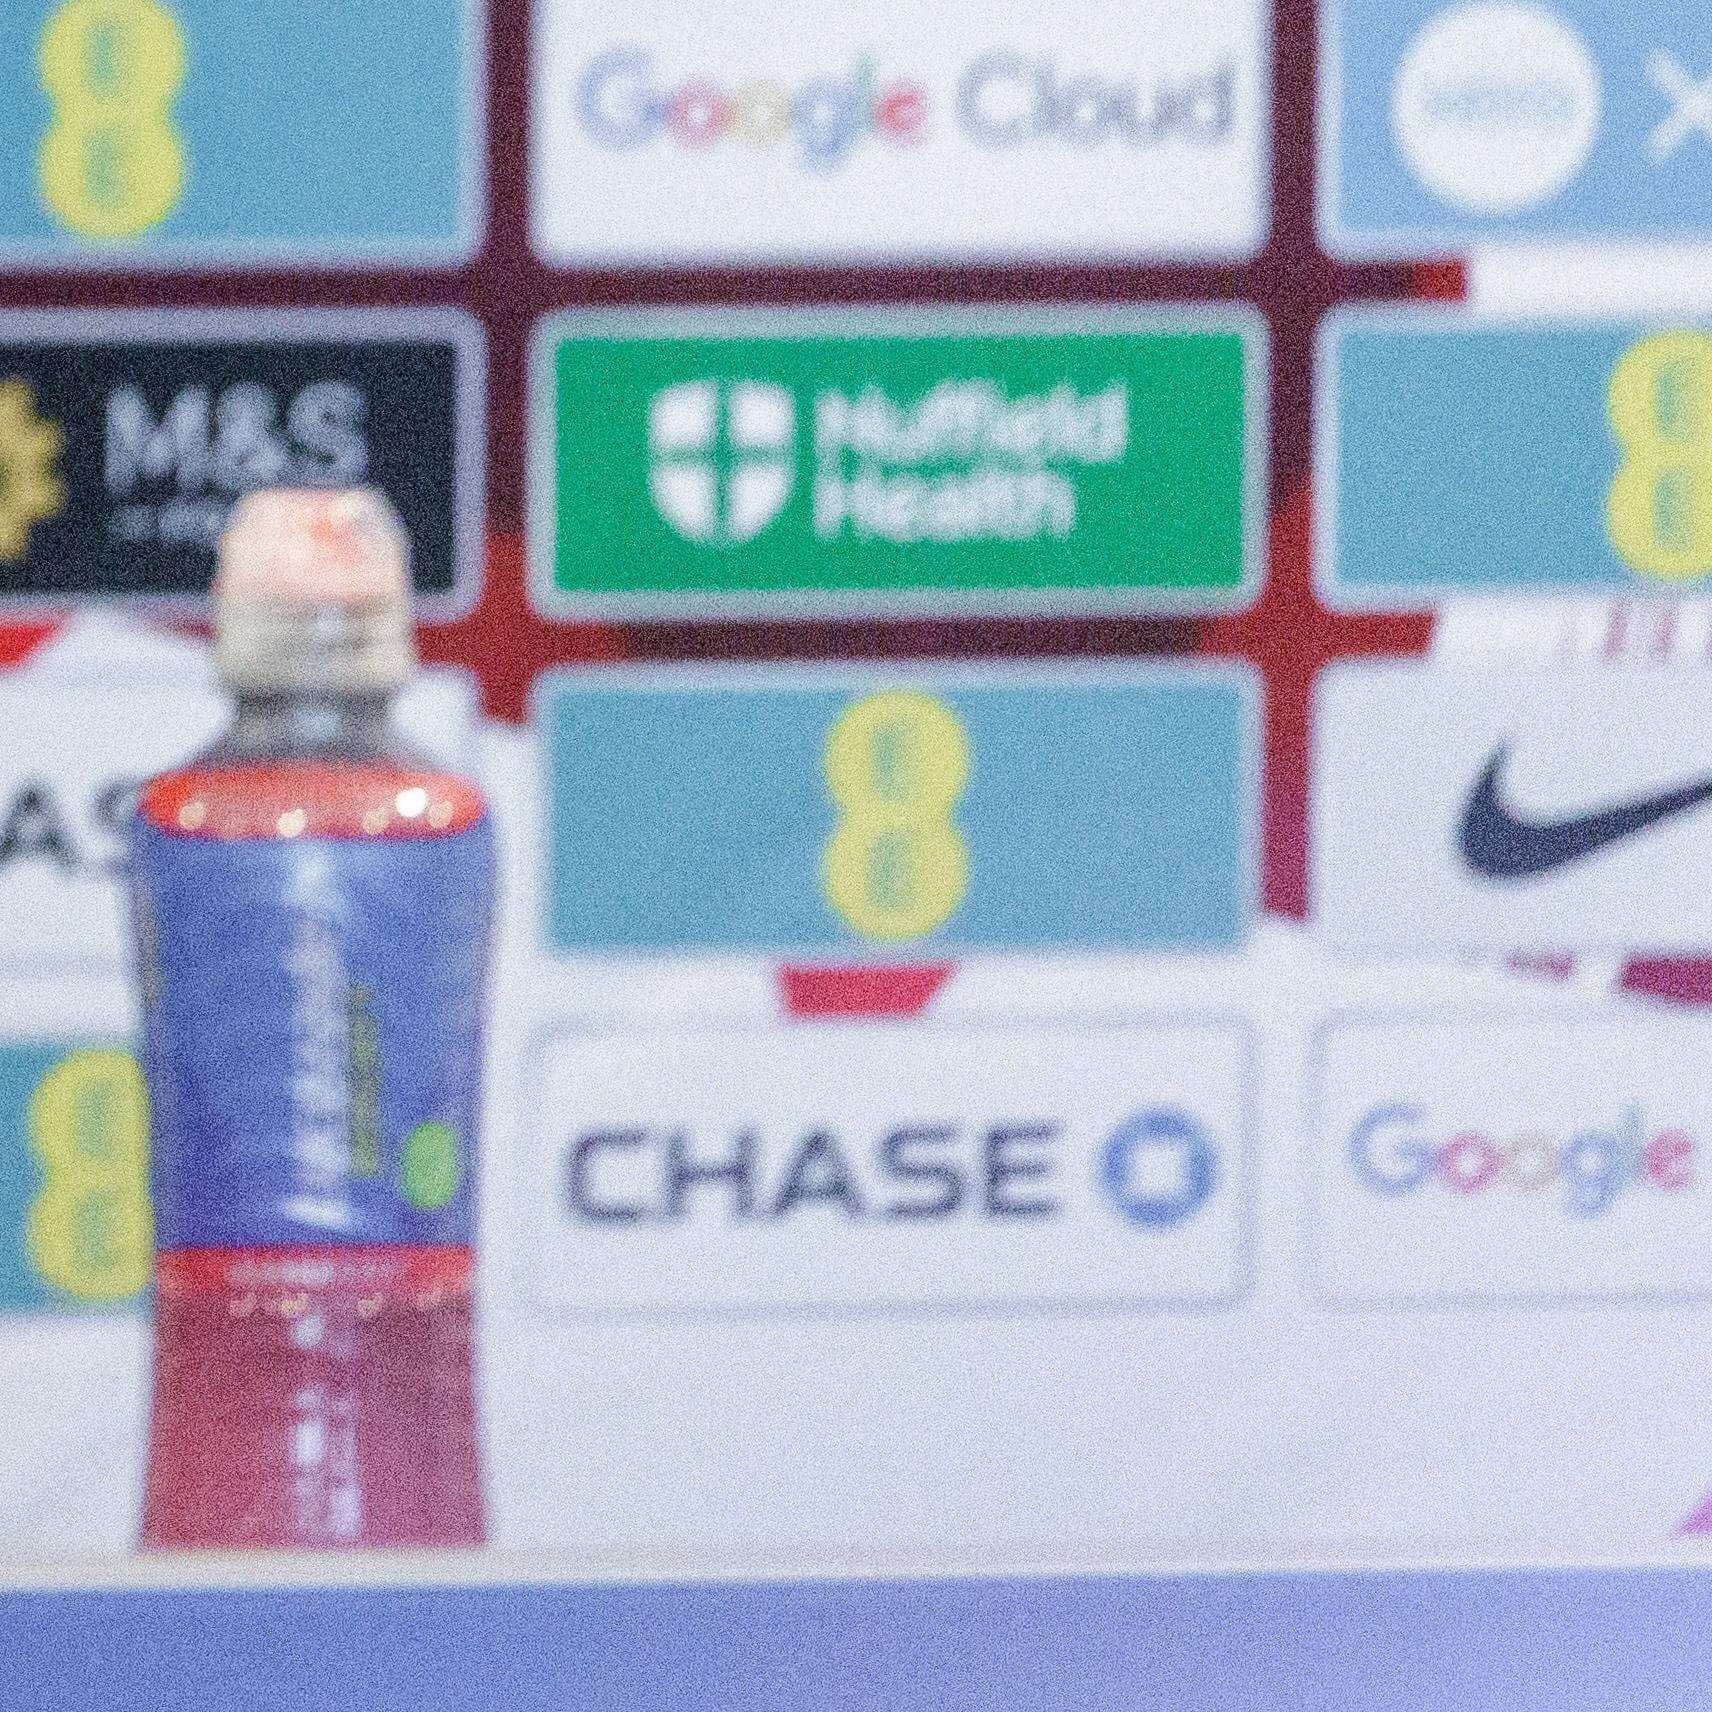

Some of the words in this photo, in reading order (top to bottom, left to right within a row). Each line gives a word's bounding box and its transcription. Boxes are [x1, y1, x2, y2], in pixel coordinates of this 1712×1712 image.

[574, 48, 927, 170] Google
[955, 55, 1239, 147] Cloud
[104, 380, 372, 494] M&S
[564, 1120, 1059, 1228] CHASE
[1346, 1101, 1699, 1220] Google
